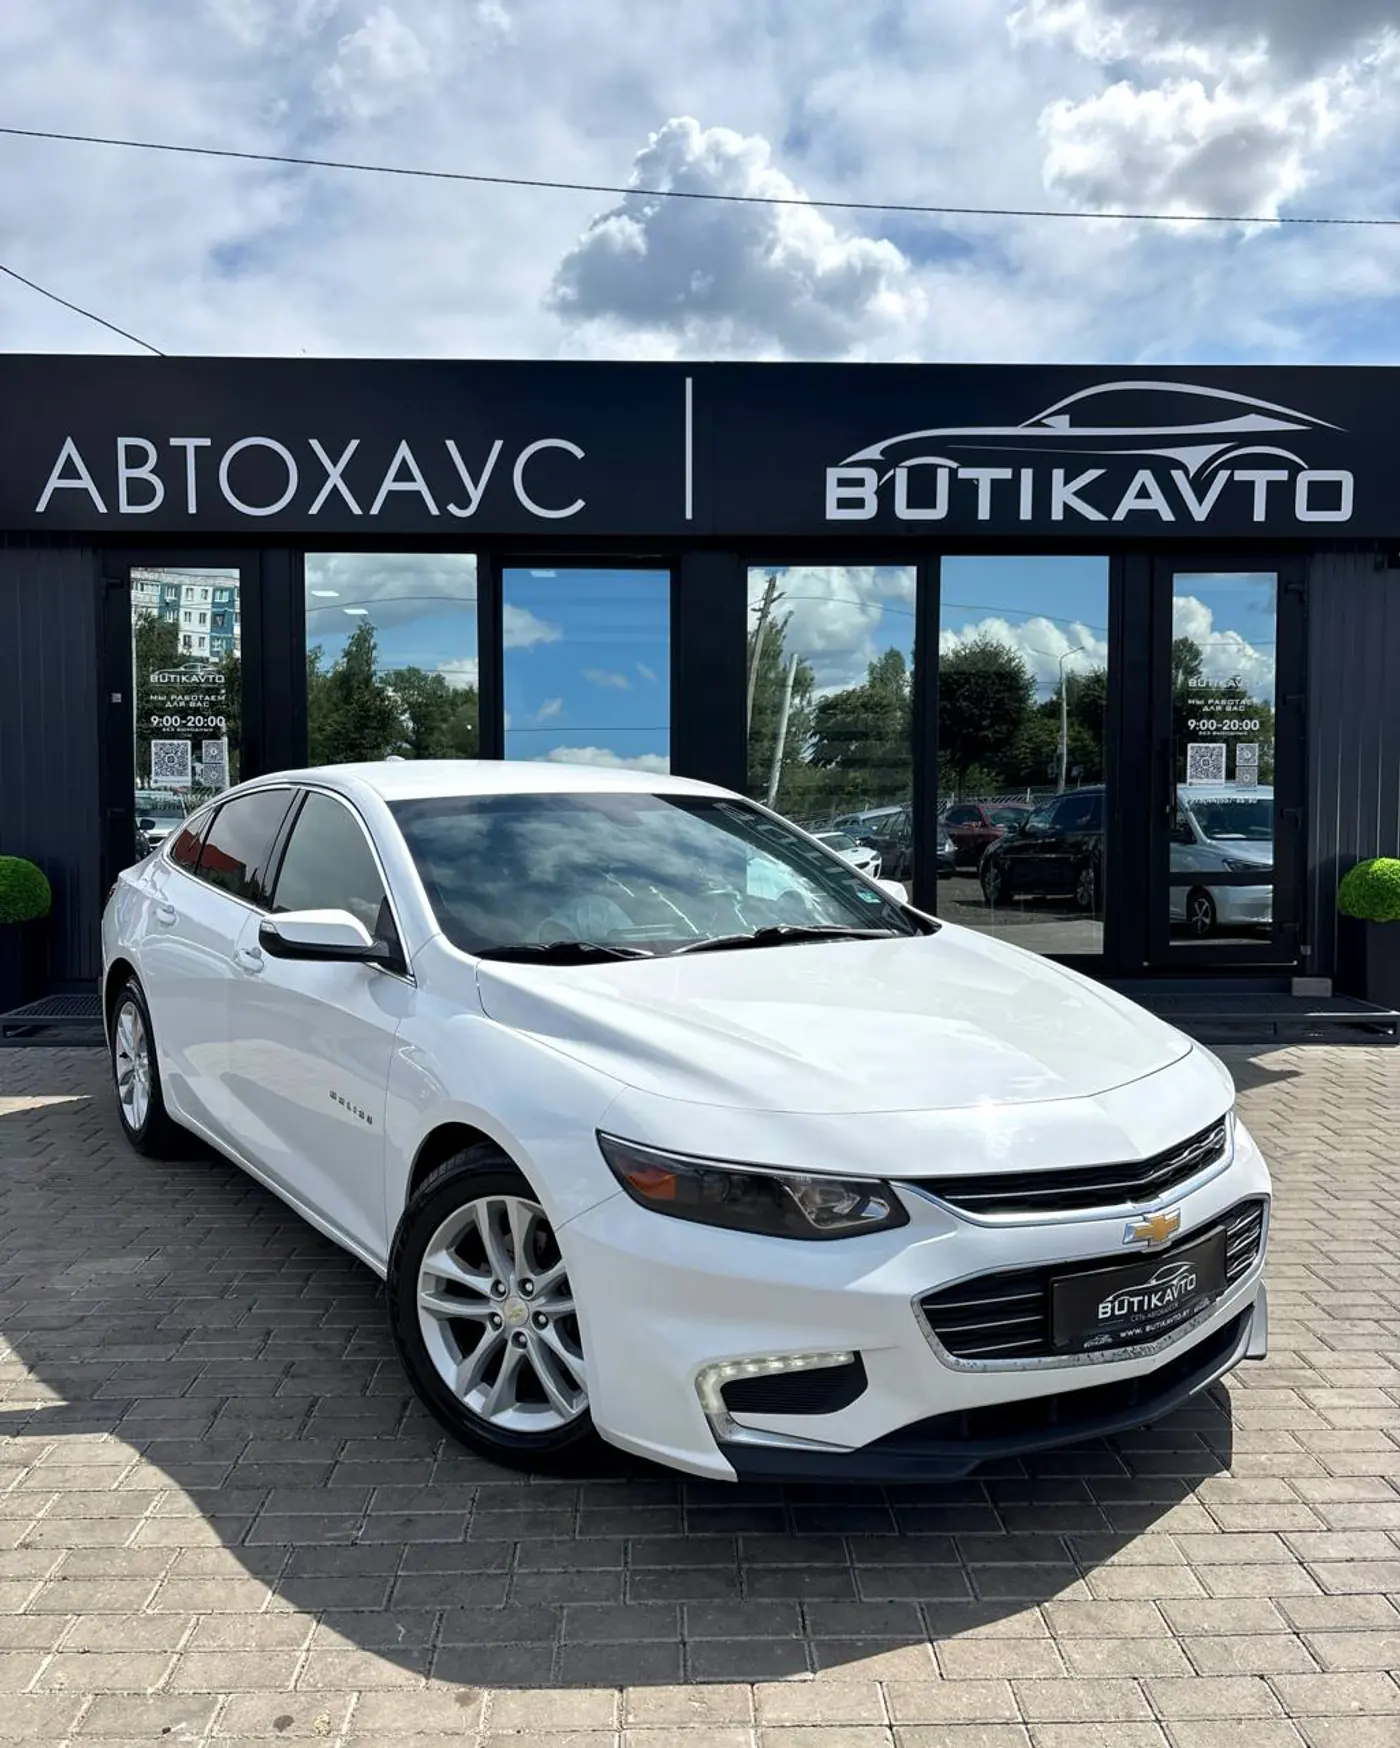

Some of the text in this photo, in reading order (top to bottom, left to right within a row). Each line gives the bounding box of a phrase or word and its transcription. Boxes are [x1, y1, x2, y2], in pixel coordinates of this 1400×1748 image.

[36, 436, 586, 519] АВТОХАУС
[825, 466, 1354, 522] BUTIKAVTO
[150, 674, 225, 683] BUTIKAVTO
[150, 715, 226, 727] 9:00-20:00
[1187, 719, 1260, 731] 9:00-20:00
[1098, 1273, 1197, 1319] BUTIKAVTO
